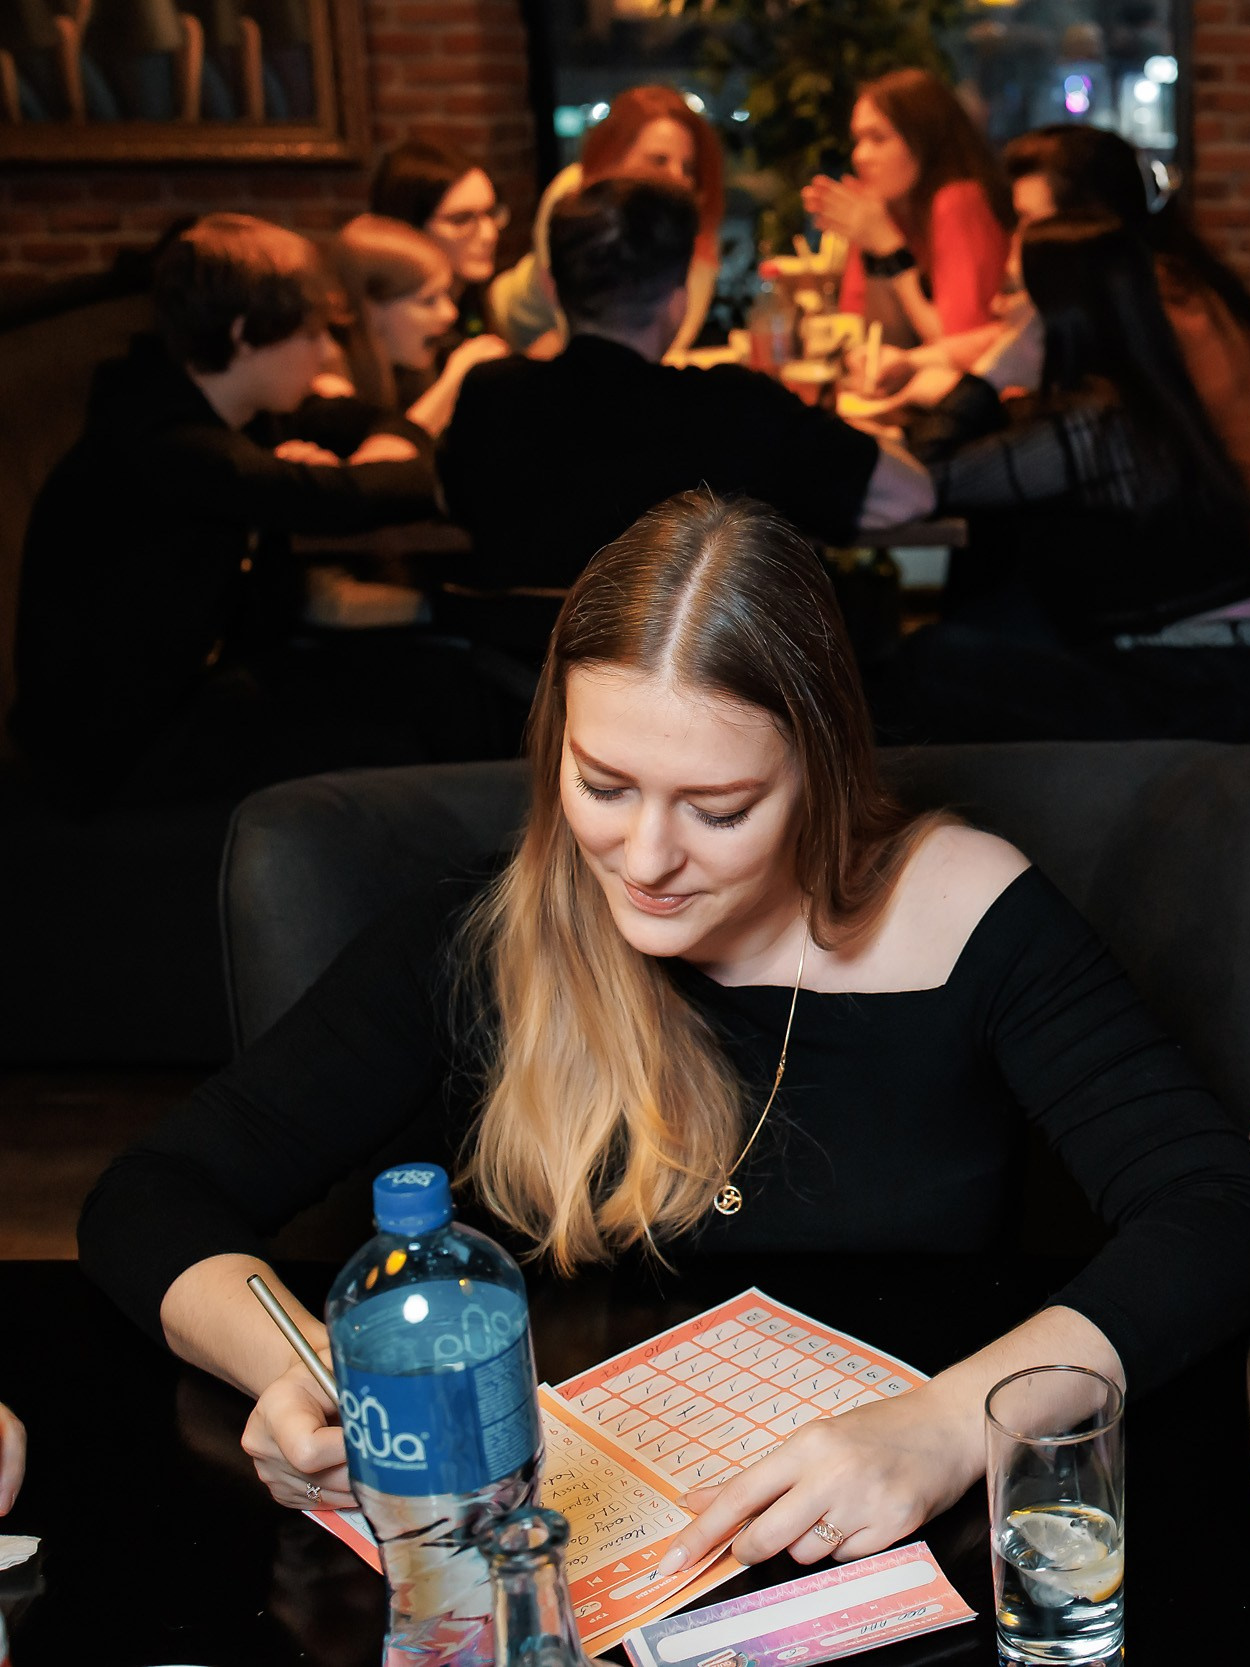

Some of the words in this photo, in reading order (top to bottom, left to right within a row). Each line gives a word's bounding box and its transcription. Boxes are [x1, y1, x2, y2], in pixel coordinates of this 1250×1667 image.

[549, 1428, 559, 1436] 9
[563, 1437, 573, 1446] 8
[580, 1448, 586, 1457] 7
[590, 1458, 599, 1466] 6
[604, 1468, 614, 1477] 5
[619, 1479, 628, 1487] 4
[633, 1489, 645, 1498] 3
[649, 1500, 659, 1509] 2
[665, 1513, 674, 1523] 1
[635, 1575, 678, 1600] КОМАНДЫ
[589, 1612, 609, 1624] ТУР
